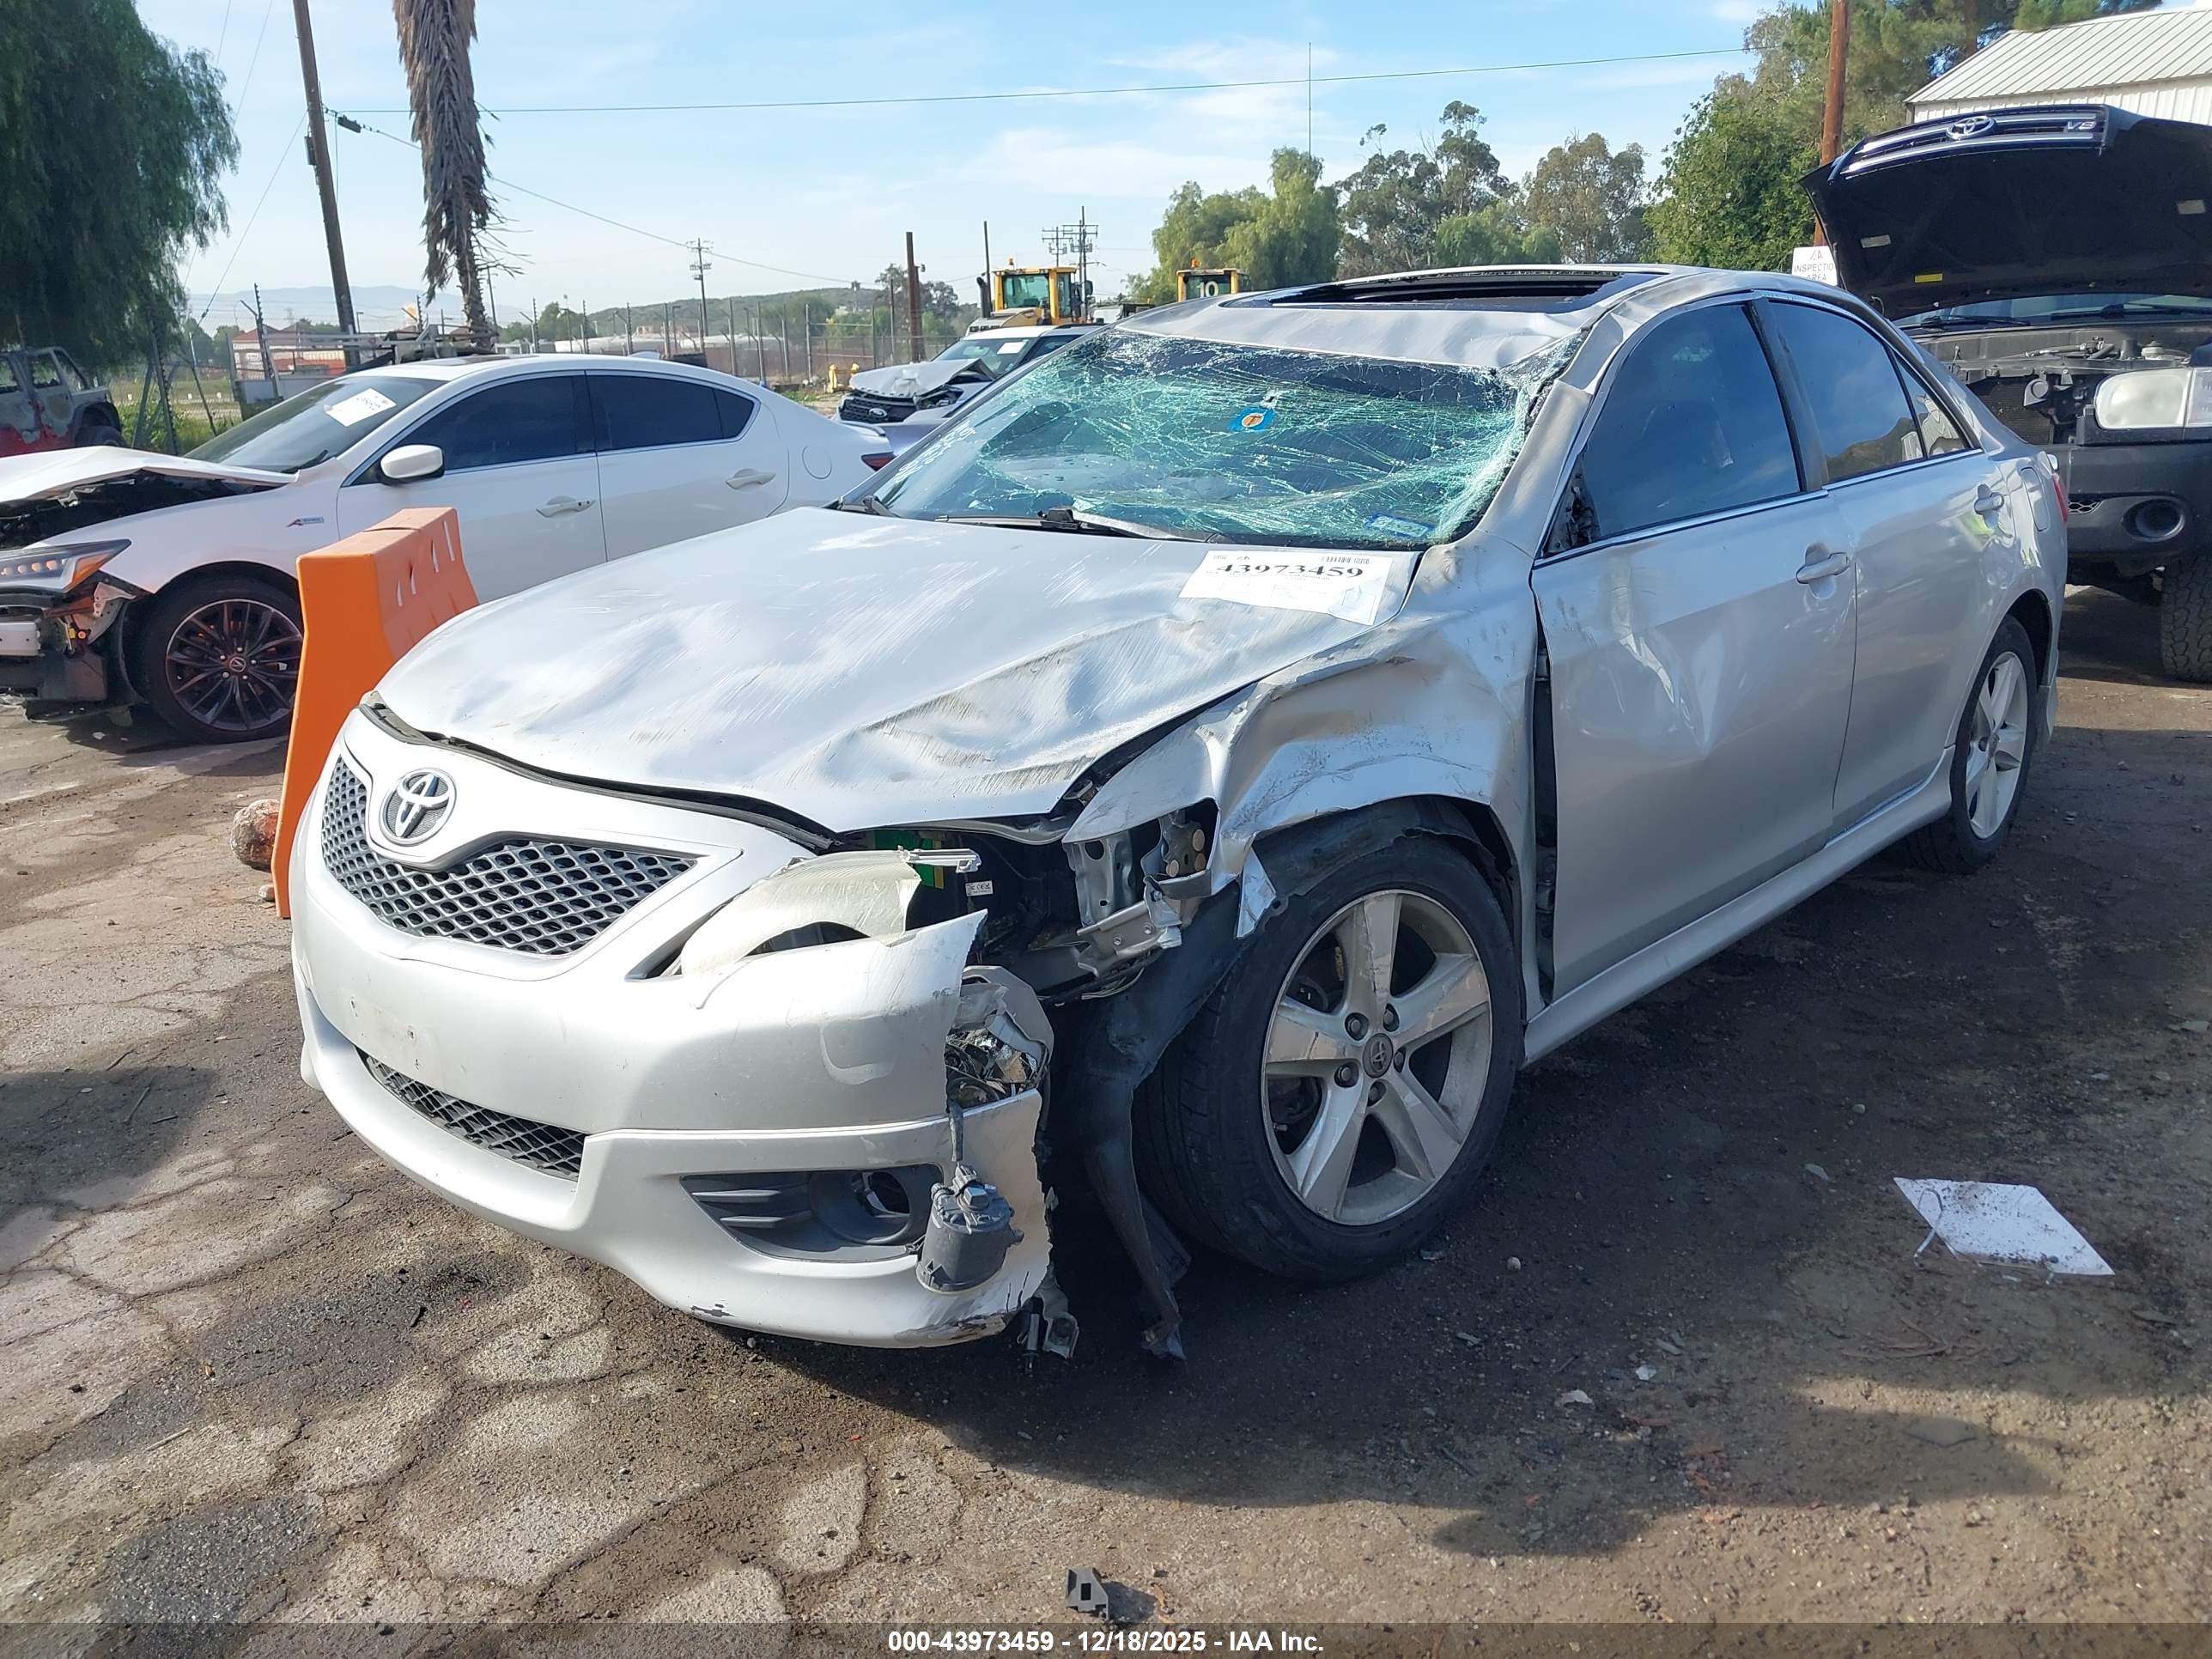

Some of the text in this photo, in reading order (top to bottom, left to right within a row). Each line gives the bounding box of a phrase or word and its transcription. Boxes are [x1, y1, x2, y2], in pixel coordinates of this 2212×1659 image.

[1794, 262, 1835, 273] INSPECTIO
[1196, 281, 1219, 298] 10
[1216, 563, 1364, 578] 43973459
